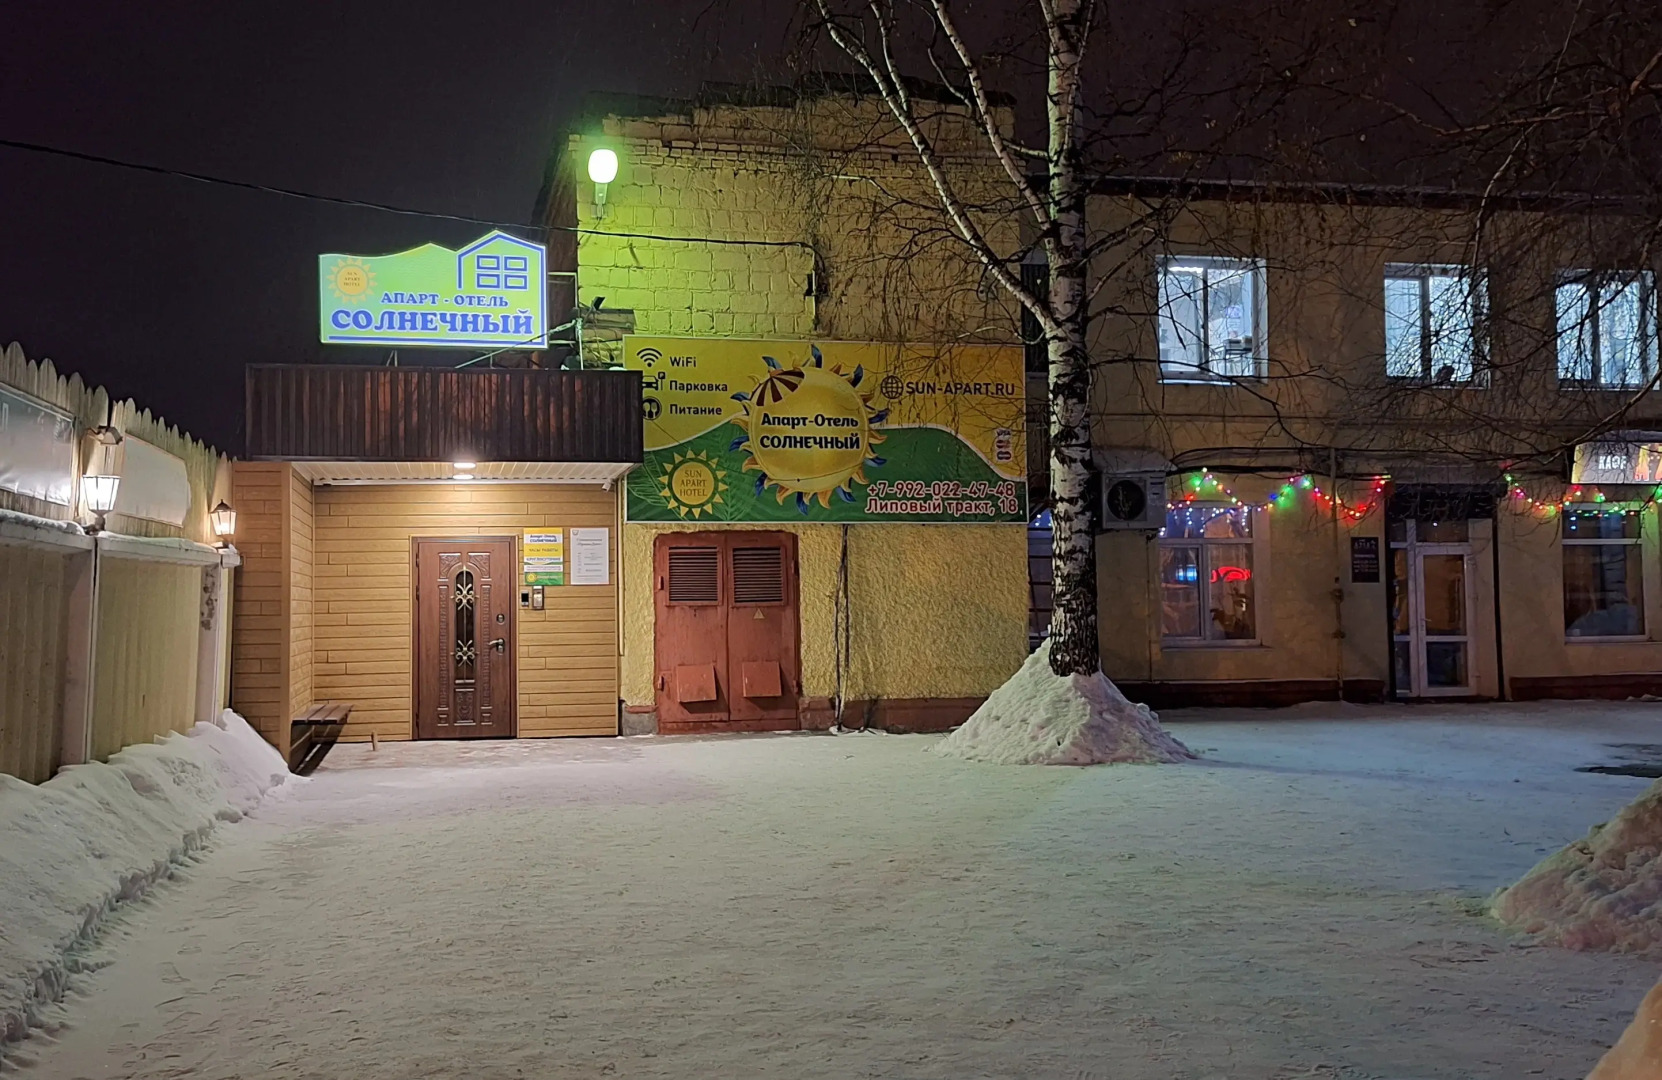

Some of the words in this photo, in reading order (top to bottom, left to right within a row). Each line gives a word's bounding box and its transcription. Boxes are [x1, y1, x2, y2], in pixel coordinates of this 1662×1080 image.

[381, 292, 439, 304] АПАРТ
[454, 295, 509, 307] ОТЕЛЬ
[331, 309, 533, 334] СОЛНЕЧНЫЙ
[669, 356, 697, 367] WiFi
[669, 380, 728, 393] Парковка
[906, 381, 1015, 396] SUN-APART.RU
[669, 404, 722, 415] Питание
[761, 412, 859, 429] Апарт-Отель
[760, 432, 860, 449] СОЛНЕЧНЫЙ
[684, 469, 702, 478] SUN
[680, 479, 707, 487] APART
[868, 482, 1015, 497] +7-992-022-47-48
[679, 488, 707, 496] HOTEL
[865, 498, 941, 513] Липовый
[946, 503, 995, 516] тракт,
[999, 499, 1017, 513] 18
